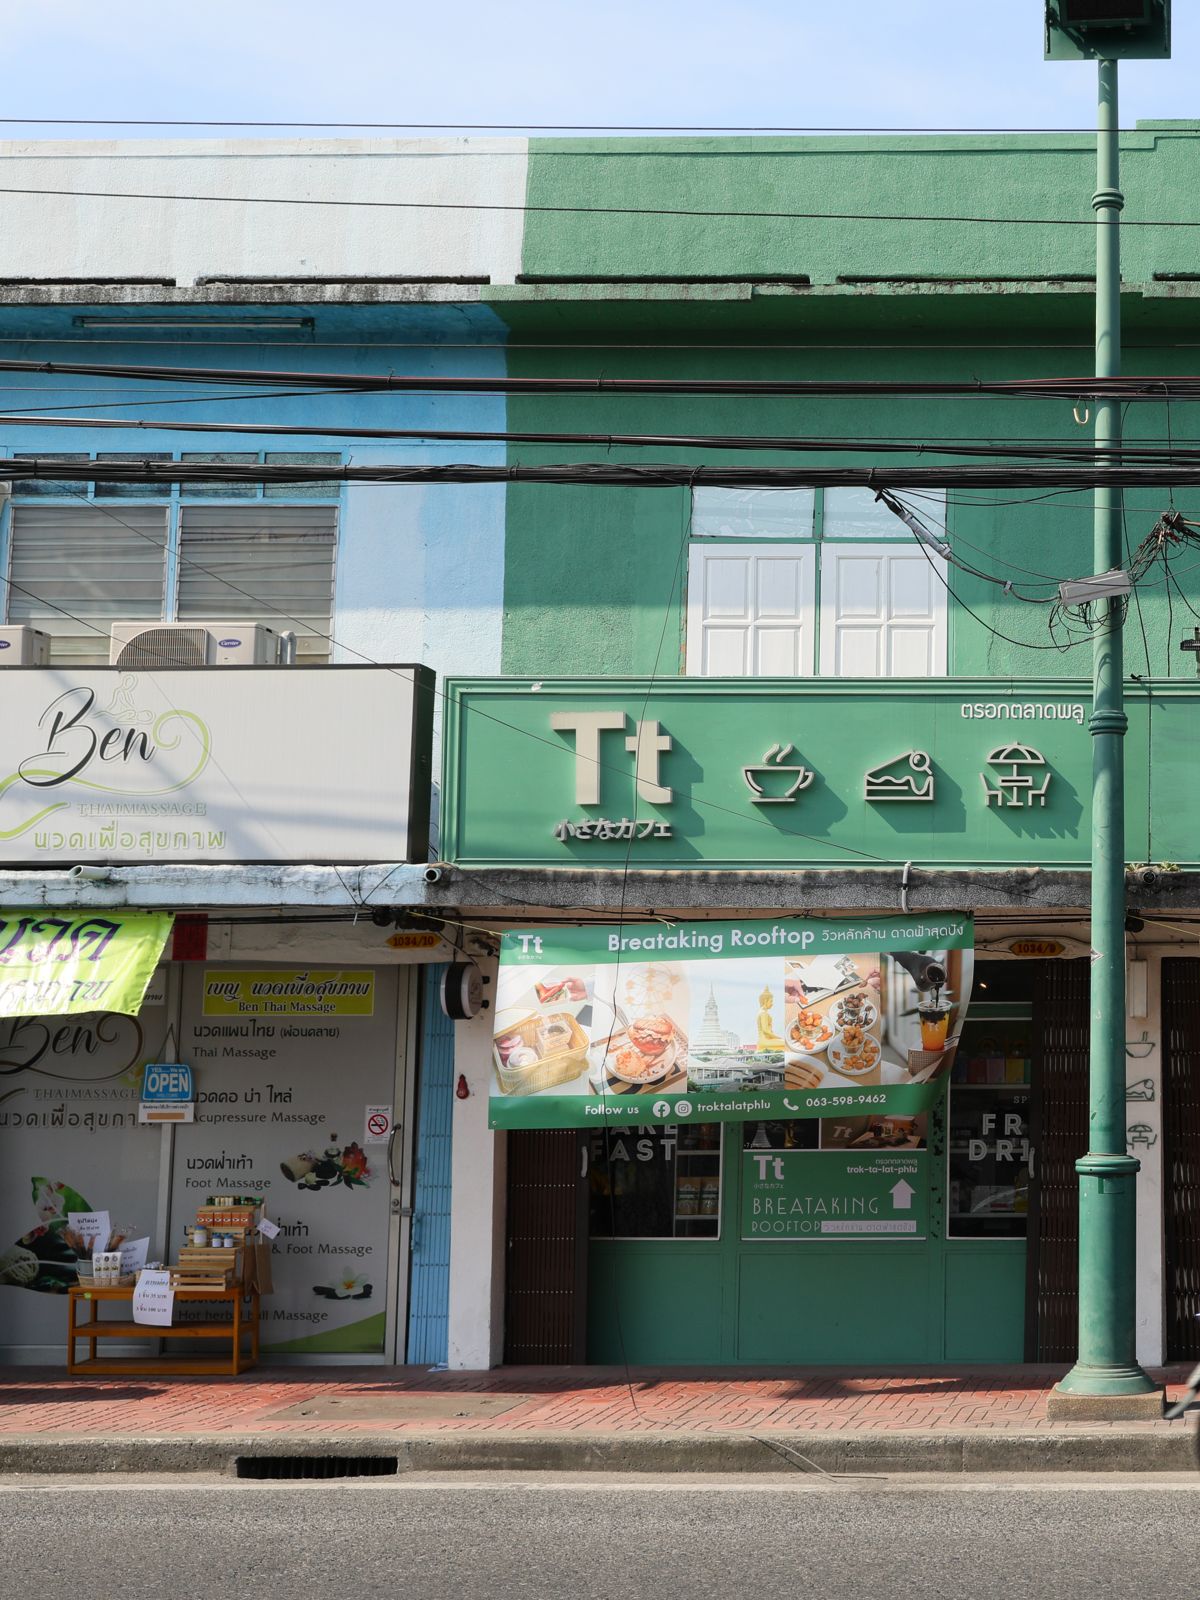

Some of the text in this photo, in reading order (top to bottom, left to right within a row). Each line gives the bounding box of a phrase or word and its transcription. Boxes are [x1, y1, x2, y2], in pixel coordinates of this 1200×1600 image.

[961, 703, 1084, 724] ตรอกตลาดพลู
[18, 687, 155, 786] Ben
[551, 711, 673, 805] Tt
[553, 818, 673, 841] 小さなカフェ
[394, 935, 434, 946] 1034/10
[517, 926, 815, 954] Tt Breataking Rooftop
[207, 972, 370, 1002] เบญ นวดเพื่อสุขภาพ
[239, 1002, 336, 1013] Ben Thai Massage
[193, 1018, 275, 1037] นวดแผนไทย
[192, 1047, 277, 1060] Thai Massage
[148, 1073, 189, 1093] OPEN
[244, 1088, 260, 1103] บ่า
[266, 1084, 292, 1103] ไหล่
[585, 1094, 886, 1115] Follow us troktalatphlu 063-598-9462
[0, 1103, 153, 1131] นวดเพื่อสุขภา
[271, 1112, 326, 1125] Massage
[187, 1150, 253, 1169] นวดฝ่าเท้า
[753, 1155, 784, 1180] Tt
[847, 1166, 918, 1174] trok-ta-lat-phlu
[185, 1178, 271, 1190] Foot Massage
[753, 1197, 879, 1215] BREATAKING
[752, 1220, 820, 1232] ROOFTOP
[272, 1244, 373, 1257] & Foot Massage
[178, 1310, 202, 1320] Hot
[273, 1310, 328, 1323] Massage
